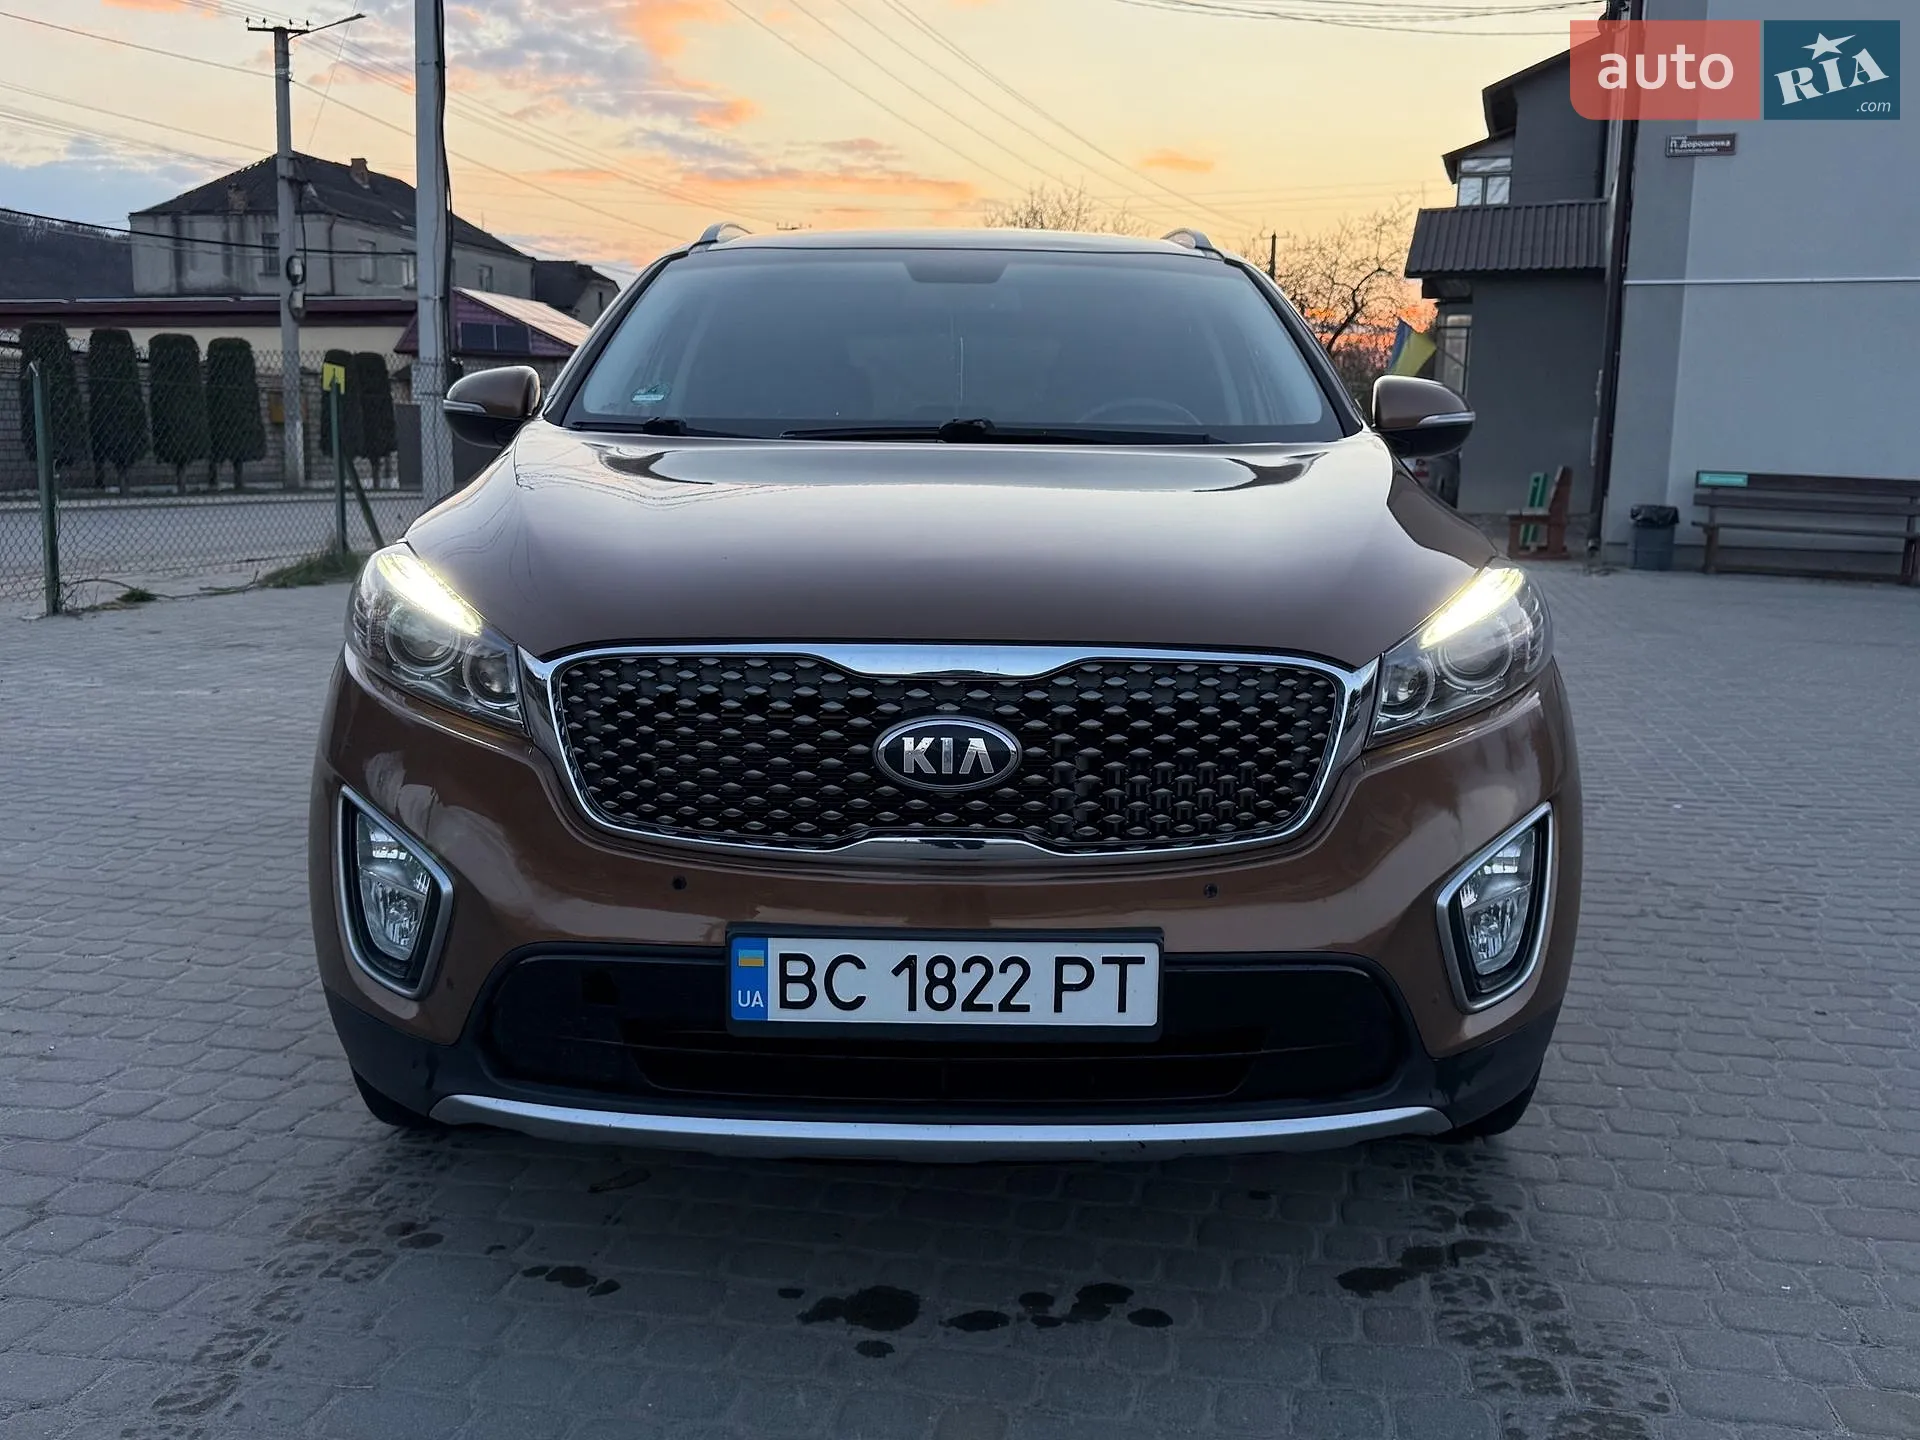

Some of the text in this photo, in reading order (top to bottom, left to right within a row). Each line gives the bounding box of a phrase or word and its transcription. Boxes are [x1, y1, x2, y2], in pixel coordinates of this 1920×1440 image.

[902, 737, 994, 774] KIA
[737, 990, 764, 1008] UA
[778, 952, 1146, 1013] BC 1822 PT
